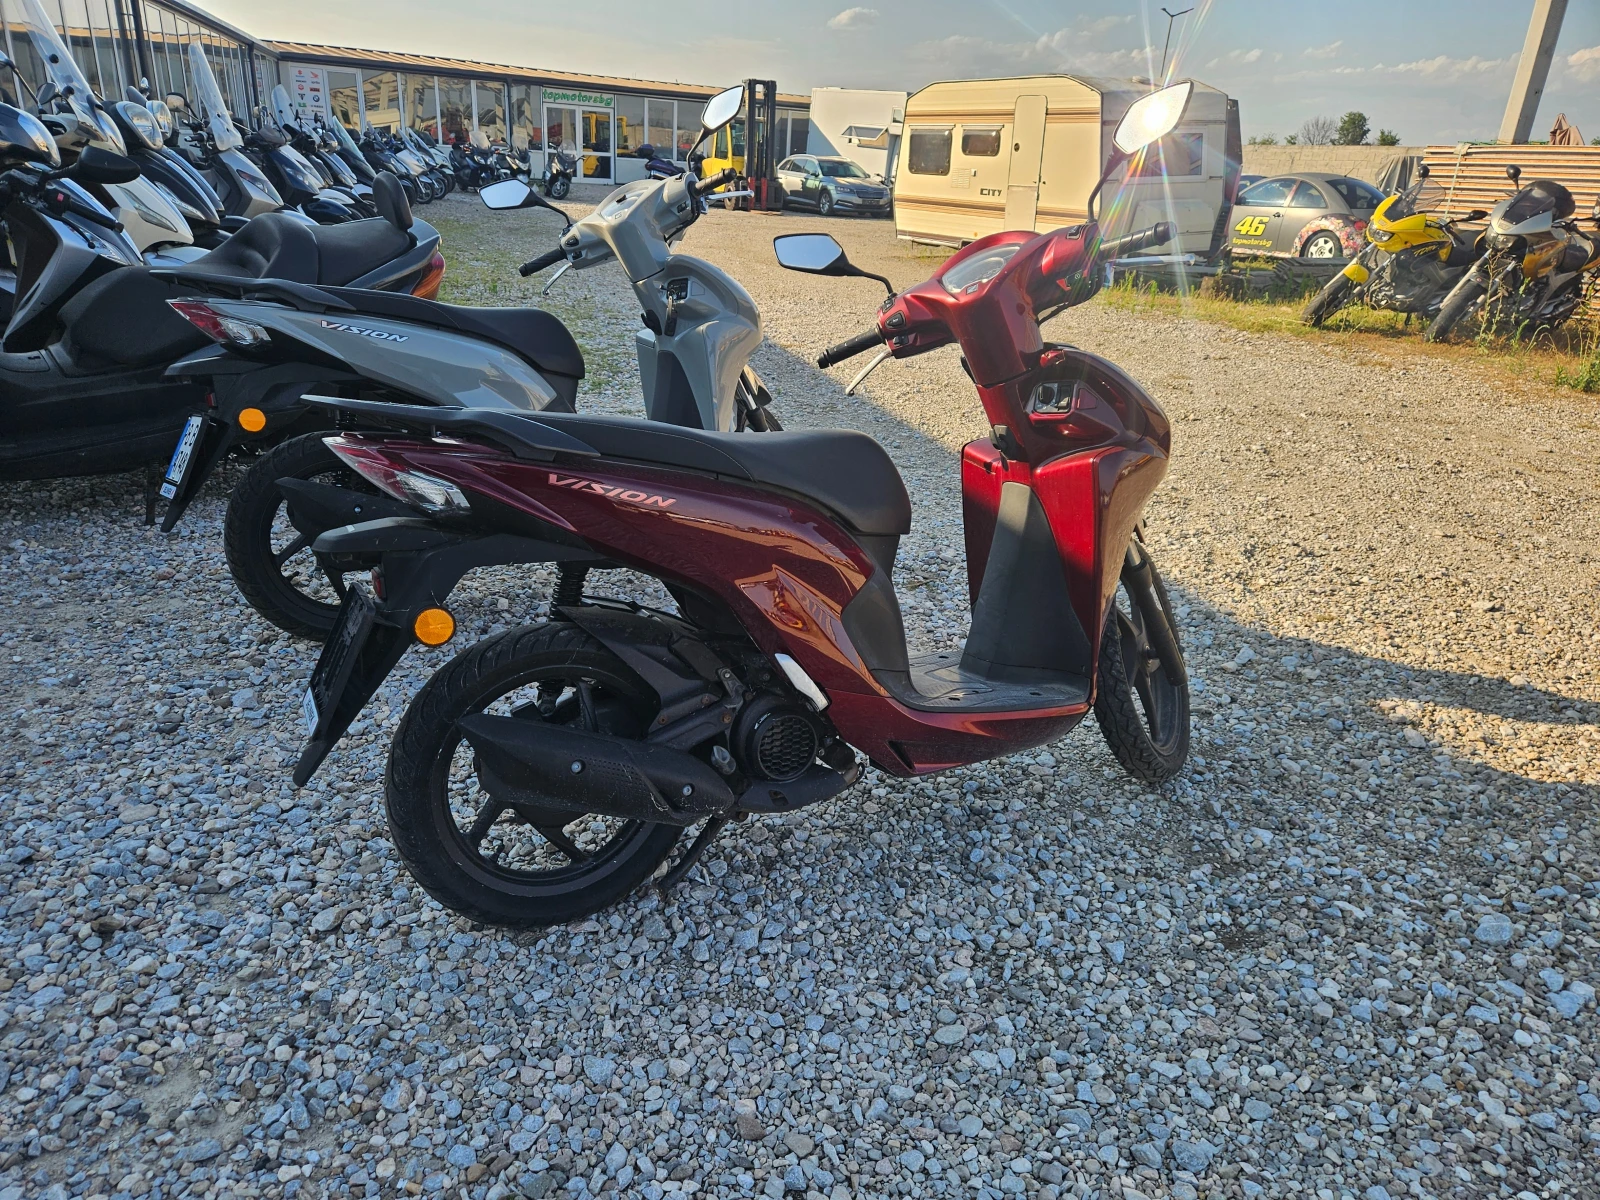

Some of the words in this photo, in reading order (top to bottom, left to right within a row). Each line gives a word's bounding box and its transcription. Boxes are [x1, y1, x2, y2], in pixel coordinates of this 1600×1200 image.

[543, 89, 613, 106] topmotorsbg
[980, 188, 1002, 197] CITY
[1234, 215, 1271, 237] 46
[1232, 237, 1273, 248] topmotorsbg
[320, 319, 409, 343] VISION
[547, 473, 678, 509] VISION
